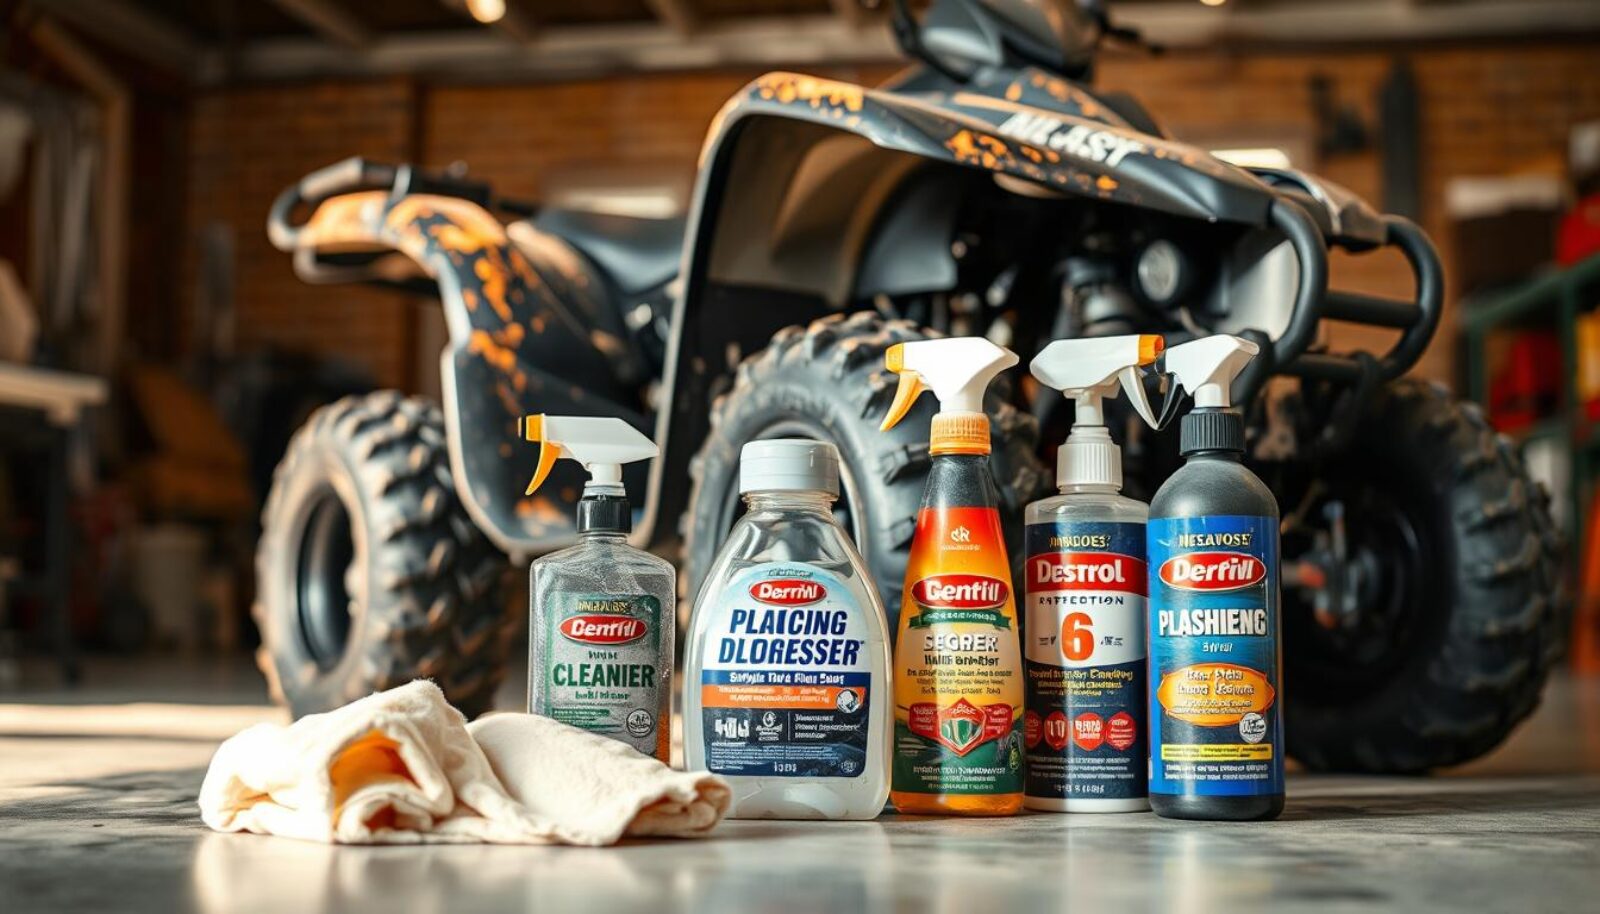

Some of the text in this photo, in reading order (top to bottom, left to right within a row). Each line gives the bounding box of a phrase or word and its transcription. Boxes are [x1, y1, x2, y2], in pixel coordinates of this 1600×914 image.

[1061, 611, 1095, 661] 6
[1158, 608, 1267, 637] PLASHIENG
[552, 663, 656, 688] CLEANIER
